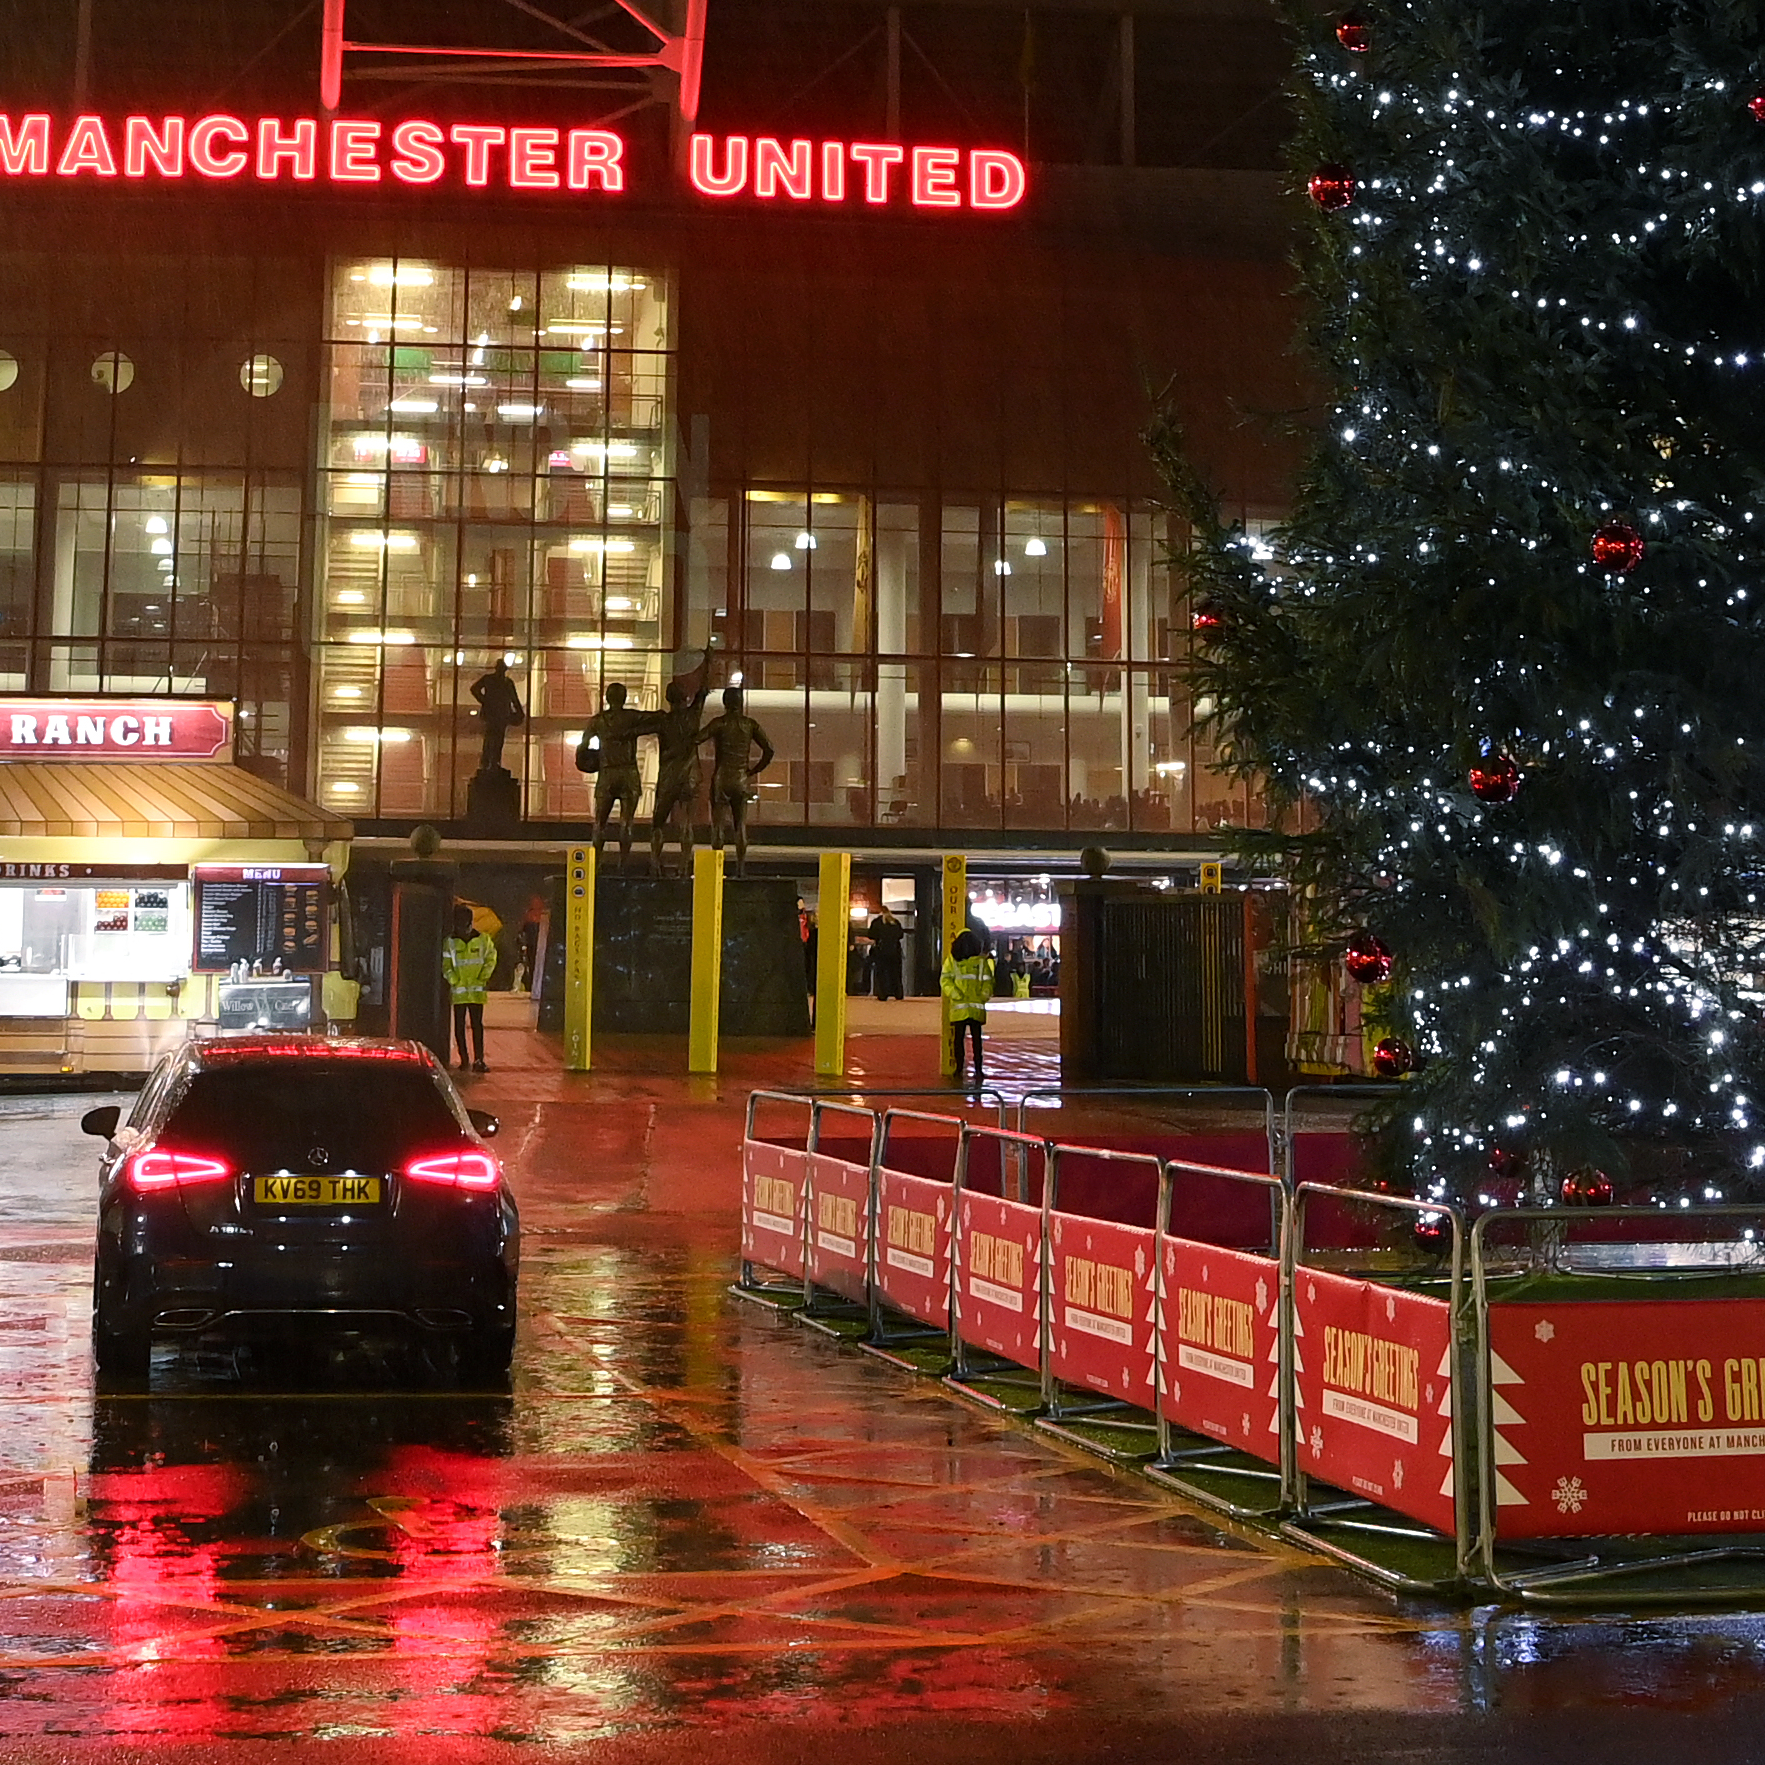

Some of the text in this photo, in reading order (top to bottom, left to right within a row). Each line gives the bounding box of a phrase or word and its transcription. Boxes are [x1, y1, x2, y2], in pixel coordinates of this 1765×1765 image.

[688, 133, 1028, 210] UNITED
[10, 714, 174, 747] RANCH
[242, 868, 282, 880] MENU
[220, 1000, 254, 1012] Willow
[264, 1179, 370, 1200] KV69 THK
[1322, 1325, 1372, 1395] SEASON'S
[1372, 1337, 1420, 1411] GREETINGS
[1581, 1358, 1712, 1426] SEASON'S
[1610, 1438, 1642, 1452] FROM
[1646, 1436, 1704, 1452] EVERYONE
[1708, 1435, 1722, 1449] AT
[1687, 1510, 1717, 1523] PLEASE
